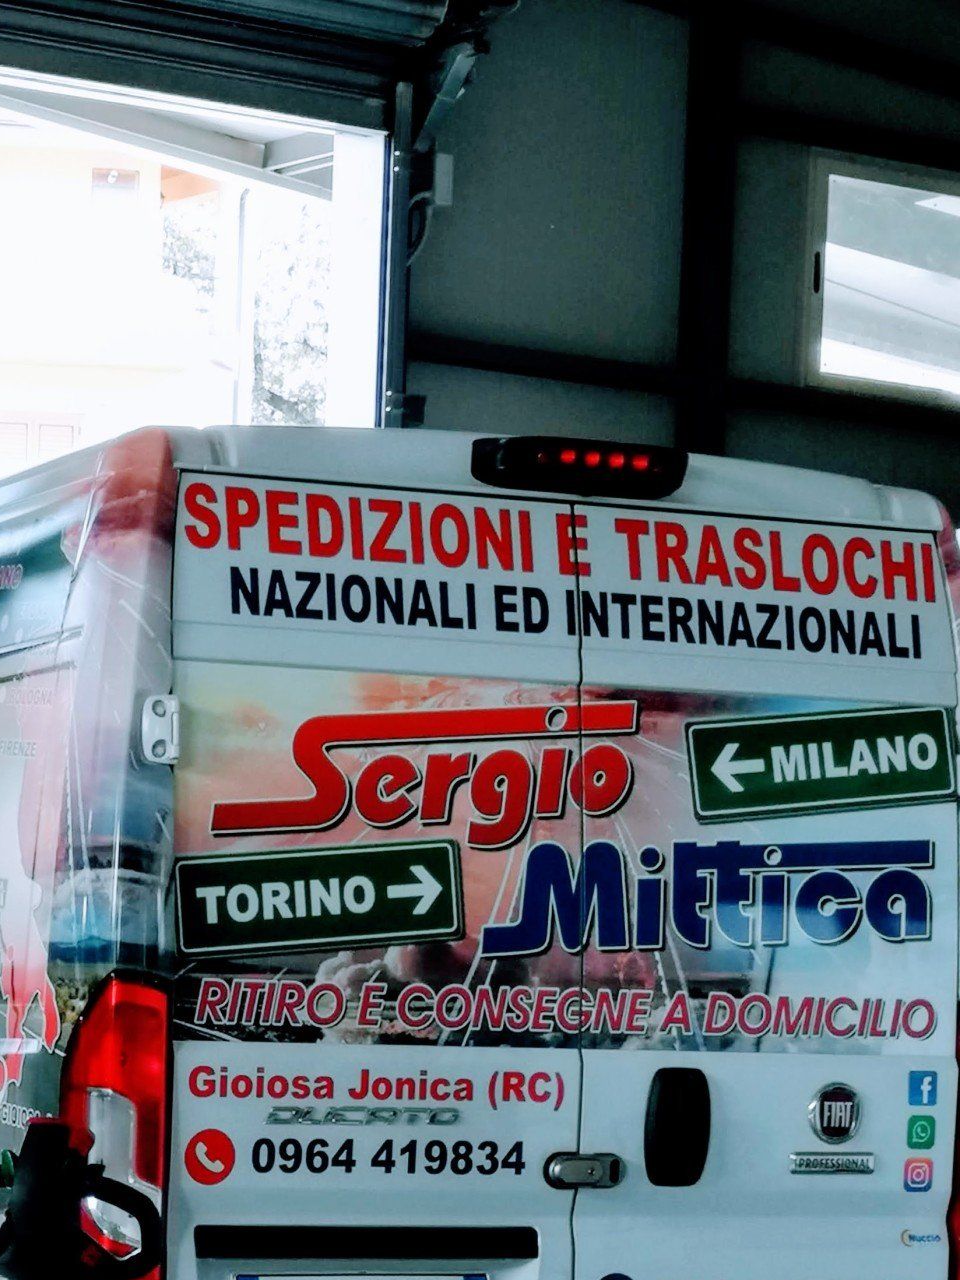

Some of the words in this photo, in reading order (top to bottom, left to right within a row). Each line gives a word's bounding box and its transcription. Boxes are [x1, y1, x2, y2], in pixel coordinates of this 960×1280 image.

[184, 481, 535, 575] SPEDIZIONI
[557, 513, 592, 576] E
[616, 517, 938, 603] TRASLOCHI
[230, 565, 478, 631] NAZIONALI
[495, 587, 549, 634] ED
[567, 590, 922, 660] INTERNAZIONALI
[210, 701, 638, 849] Sergio
[769, 732, 938, 784] MILANO
[196, 876, 375, 926] TORINO
[480, 839, 934, 958] Mittica
[195, 976, 348, 1028] RITIRO
[359, 981, 386, 1029] E
[414, 984, 651, 1035] CONSEGNE
[660, 990, 692, 1036] A
[701, 990, 938, 1041] DOMICILIO
[188, 1065, 335, 1102] Gioiosa
[348, 1069, 474, 1103] Jonica
[487, 1071, 566, 1110] (RC)
[265, 1106, 460, 1127] DUCATO
[823, 1101, 853, 1128] FIAT
[251, 1139, 357, 1174] 0964
[371, 1141, 526, 1176] 419834
[797, 1157, 870, 1170] PROFESSIONAL
